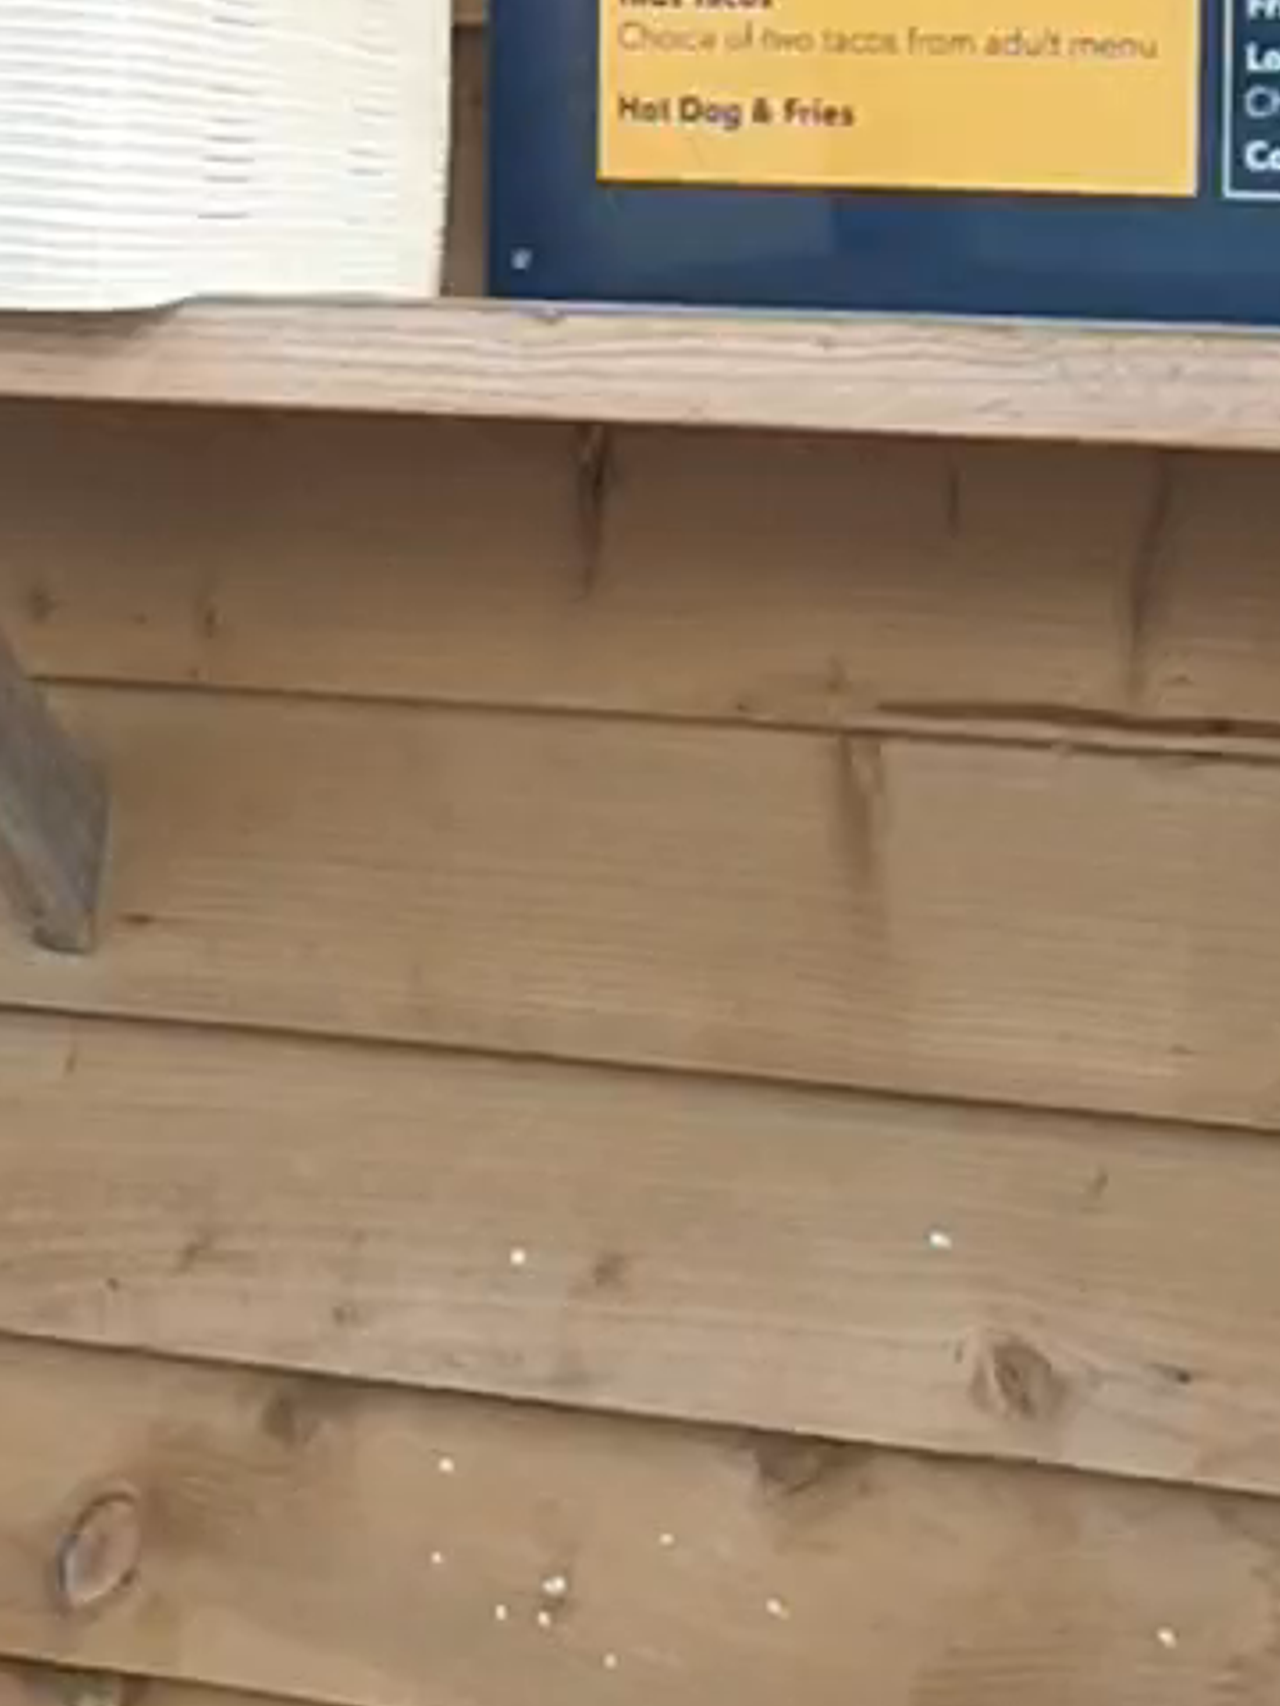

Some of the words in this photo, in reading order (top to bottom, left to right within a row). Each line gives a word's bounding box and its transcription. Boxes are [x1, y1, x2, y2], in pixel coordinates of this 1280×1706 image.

[726, 21, 753, 51] of
[761, 26, 812, 53] two
[823, 31, 897, 55] tacos
[906, 28, 976, 56] from
[984, 24, 1061, 58] adult
[1069, 36, 1159, 59] menu
[618, 97, 670, 124] Hot
[679, 99, 743, 130] Dog
[751, 99, 773, 124] &
[784, 99, 855, 126] Fries
